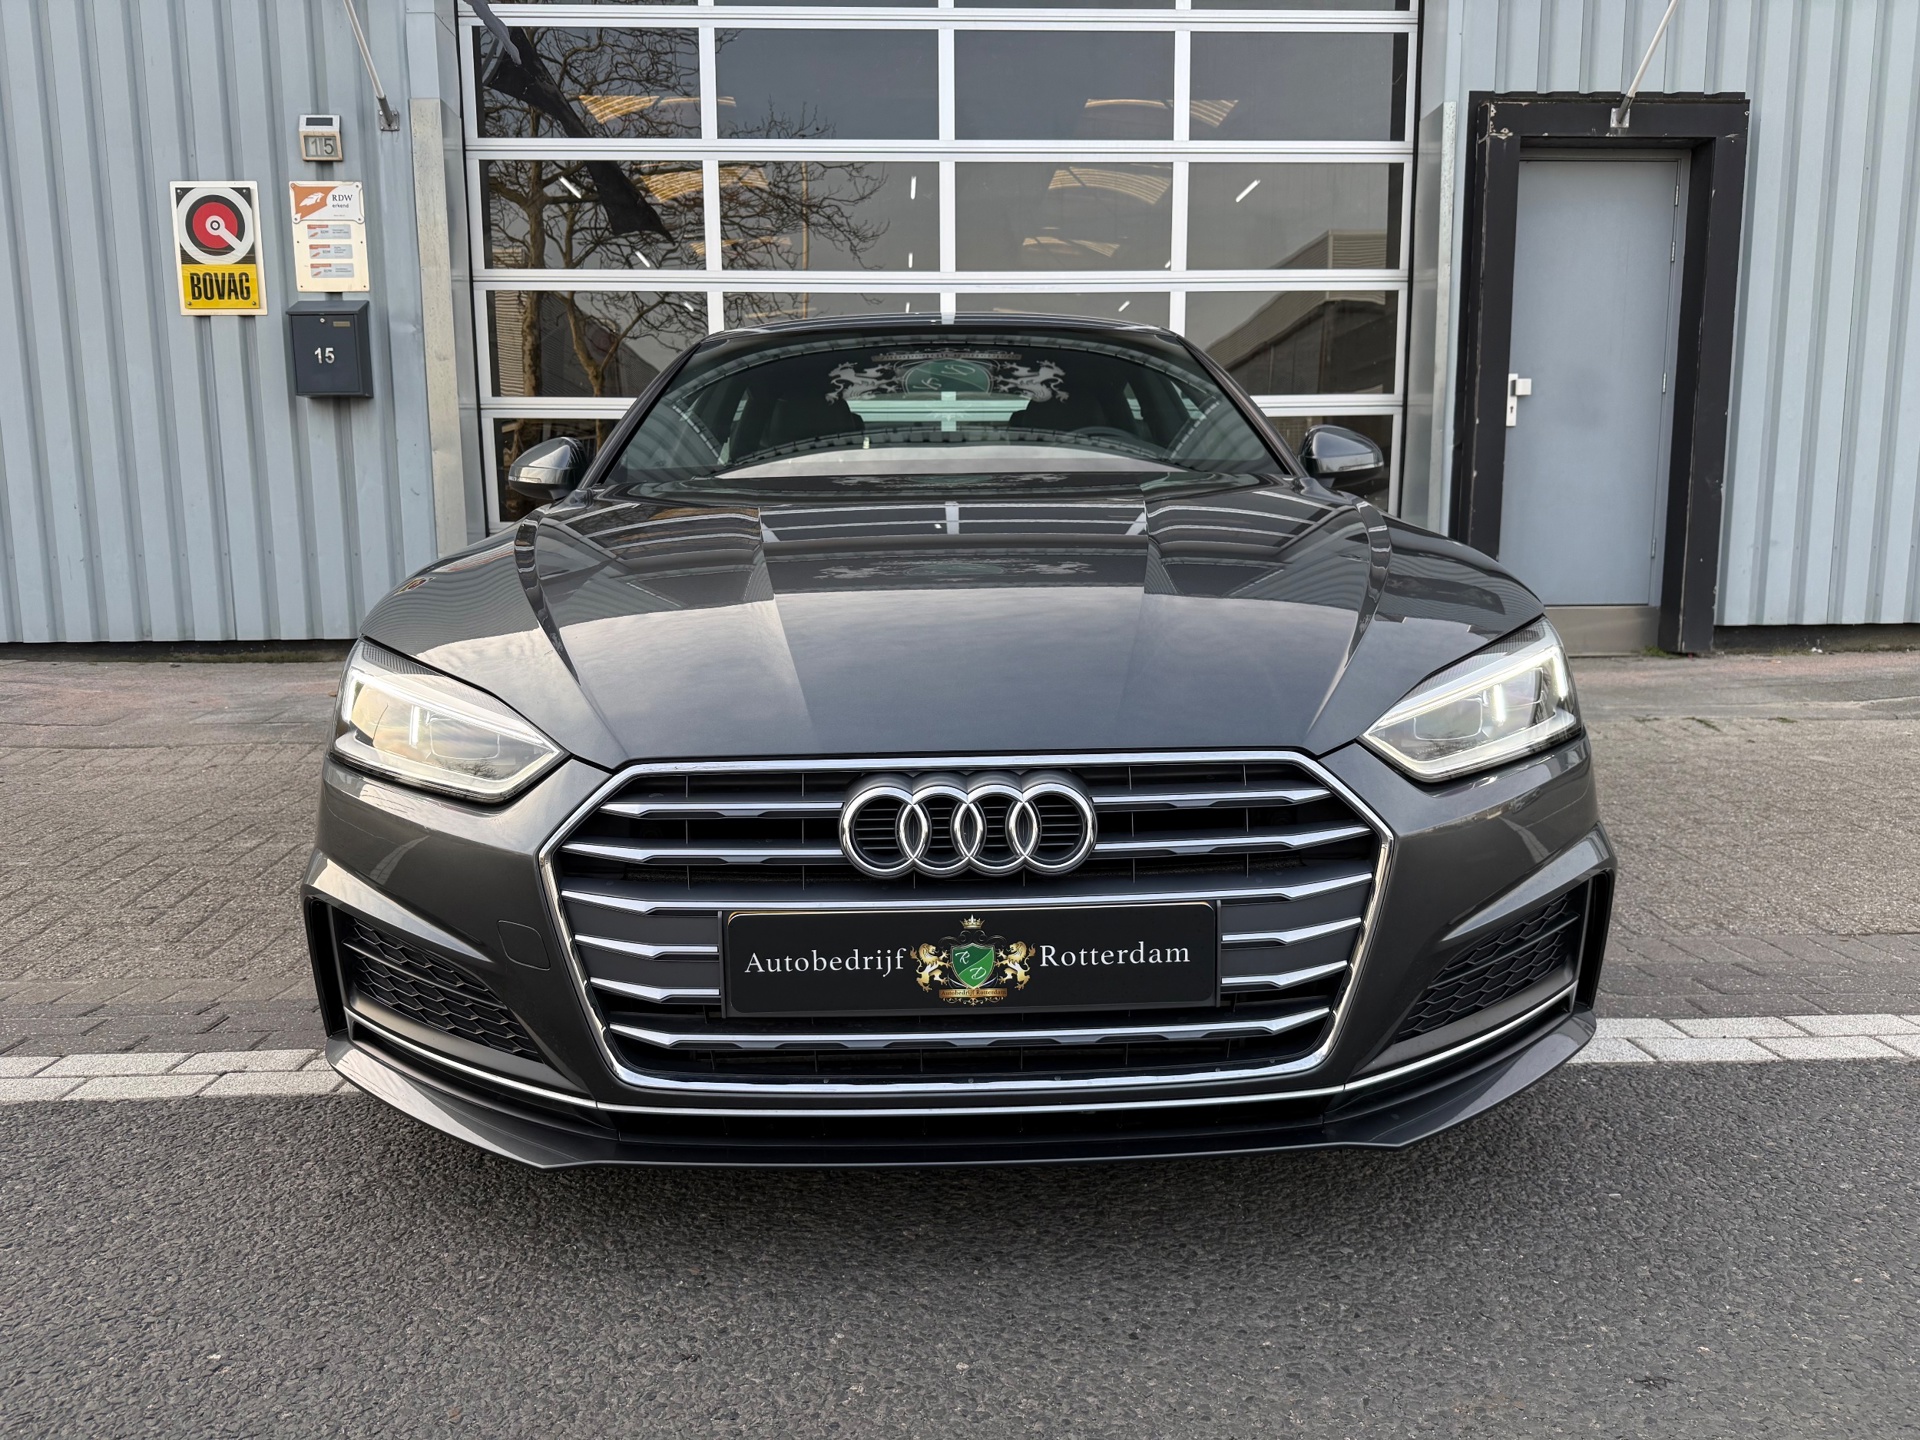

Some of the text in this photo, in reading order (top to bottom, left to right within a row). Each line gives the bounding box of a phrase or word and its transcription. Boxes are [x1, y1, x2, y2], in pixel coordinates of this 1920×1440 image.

[311, 138, 334, 155] 15
[332, 194, 353, 202] RDW
[190, 272, 251, 301] BOVAG
[314, 347, 335, 364] 15
[744, 940, 1191, 978] Autobedrijf Rotterdam
[941, 988, 1006, 997] Autobedrijf Rotterdam
